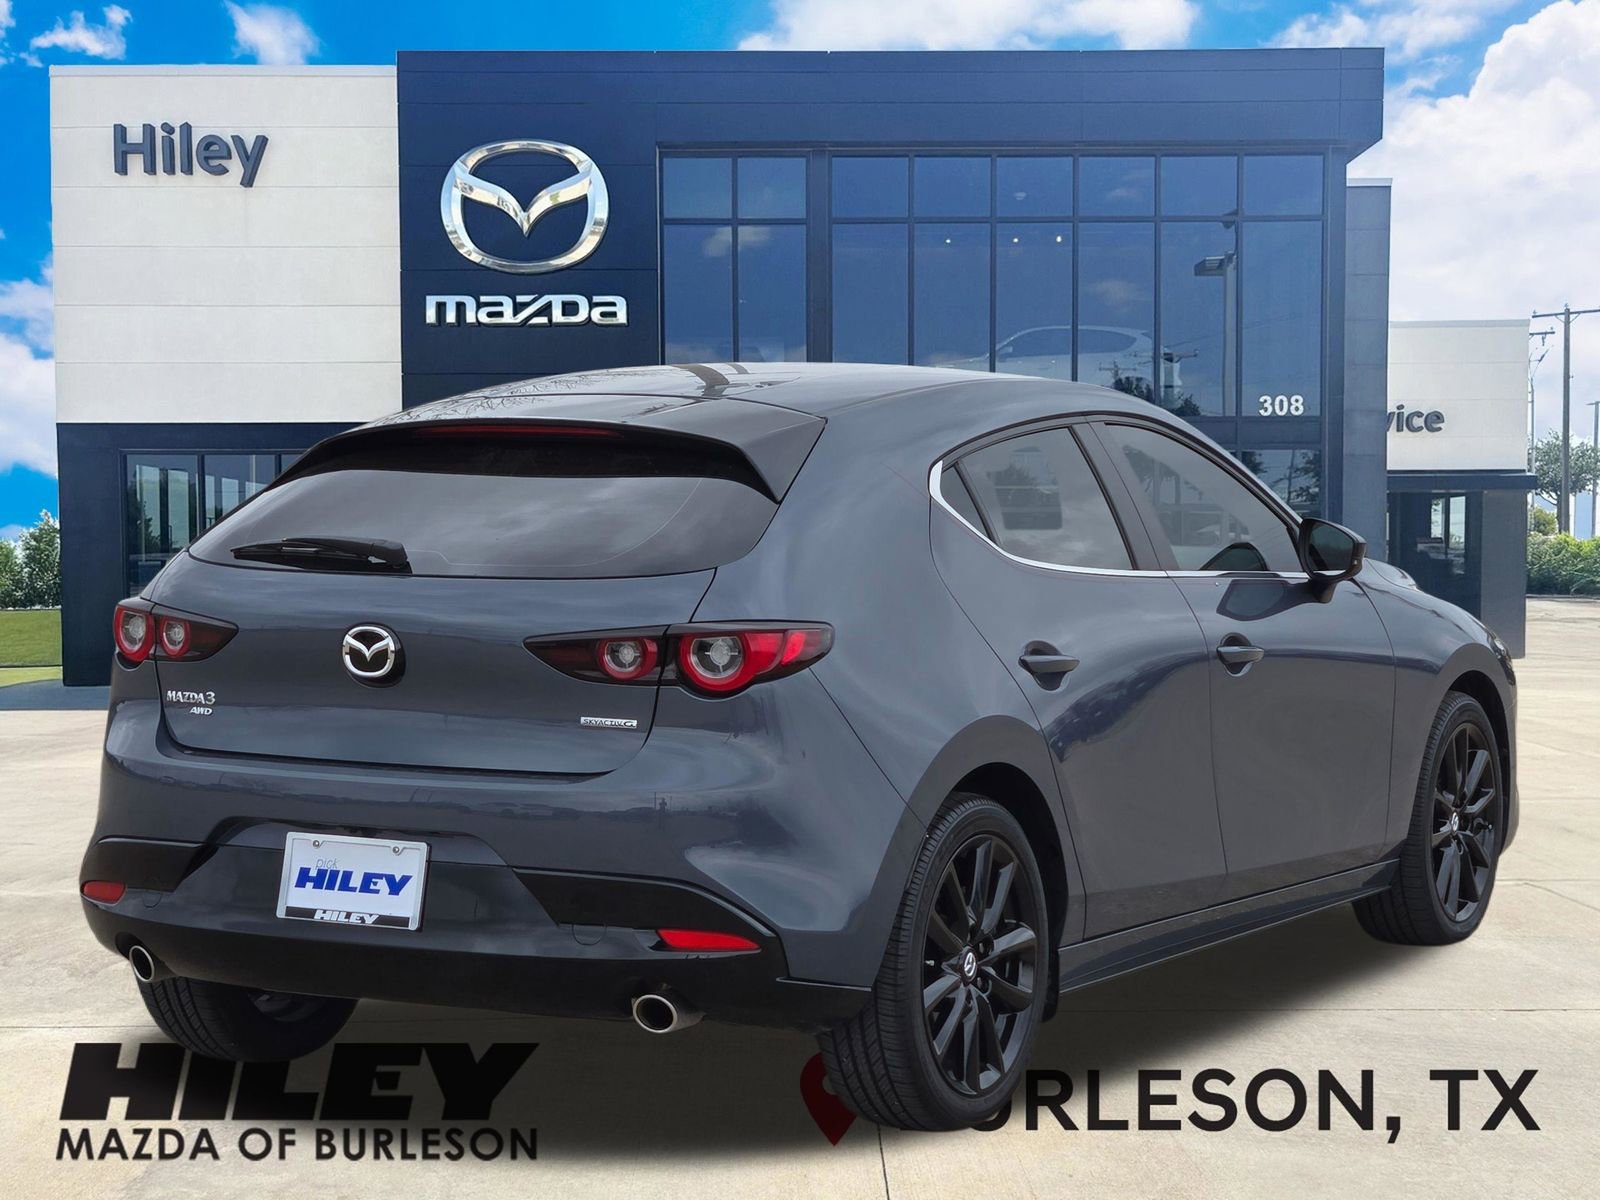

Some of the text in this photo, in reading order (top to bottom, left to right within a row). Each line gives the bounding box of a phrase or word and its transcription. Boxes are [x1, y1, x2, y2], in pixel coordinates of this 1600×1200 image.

[113, 121, 269, 188] Hiley
[1258, 394, 1304, 416] 308
[190, 706, 213, 715] AWD
[294, 866, 413, 896] HILEY
[313, 909, 380, 924] HILEY
